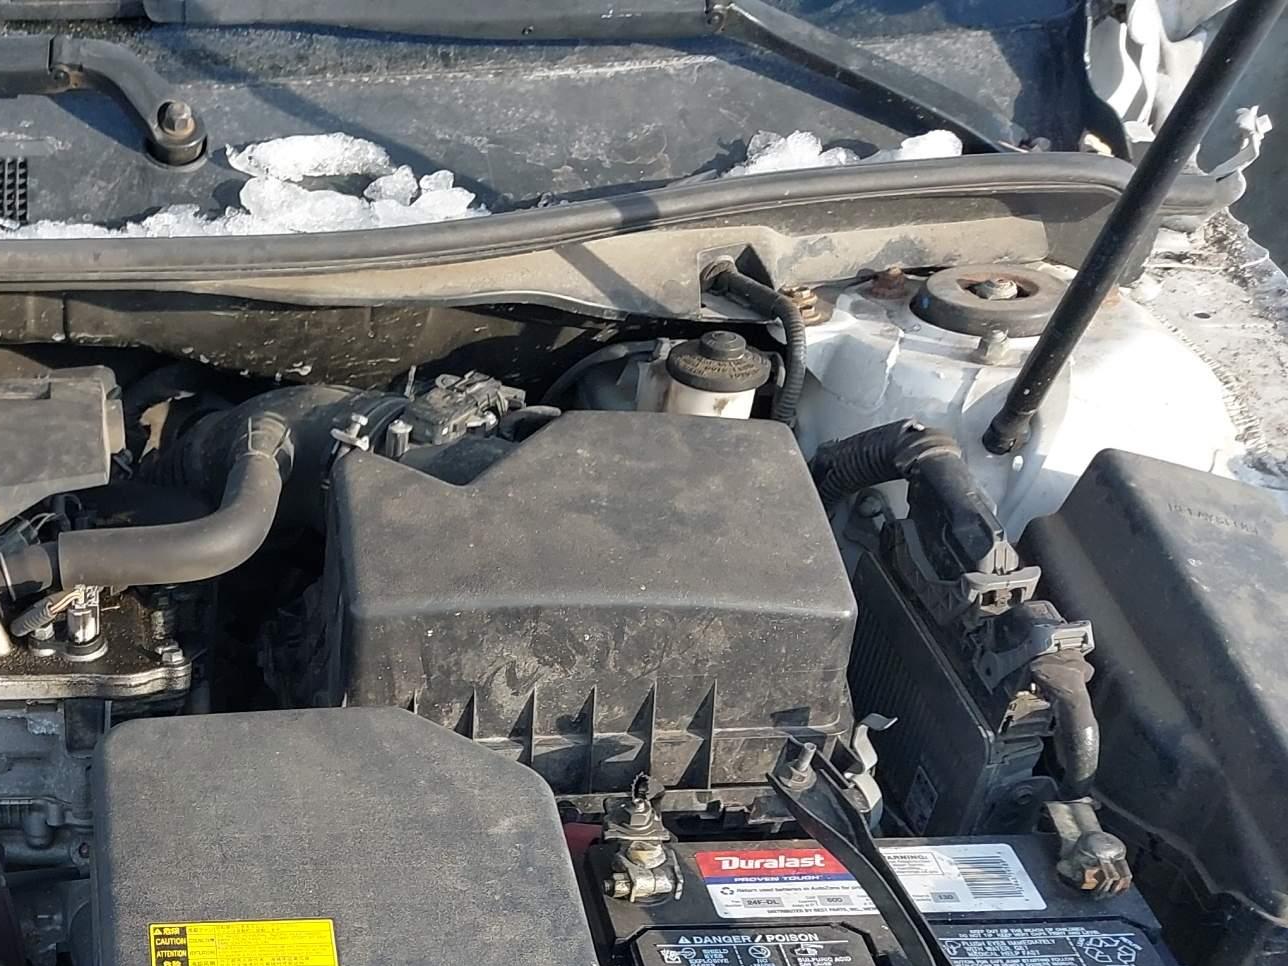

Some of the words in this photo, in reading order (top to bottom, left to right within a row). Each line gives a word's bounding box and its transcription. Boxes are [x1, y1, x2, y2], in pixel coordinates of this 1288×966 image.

[714, 854, 825, 870] Duralast
[766, 934, 819, 942] POISON
[156, 950, 187, 958] ATTENTION
